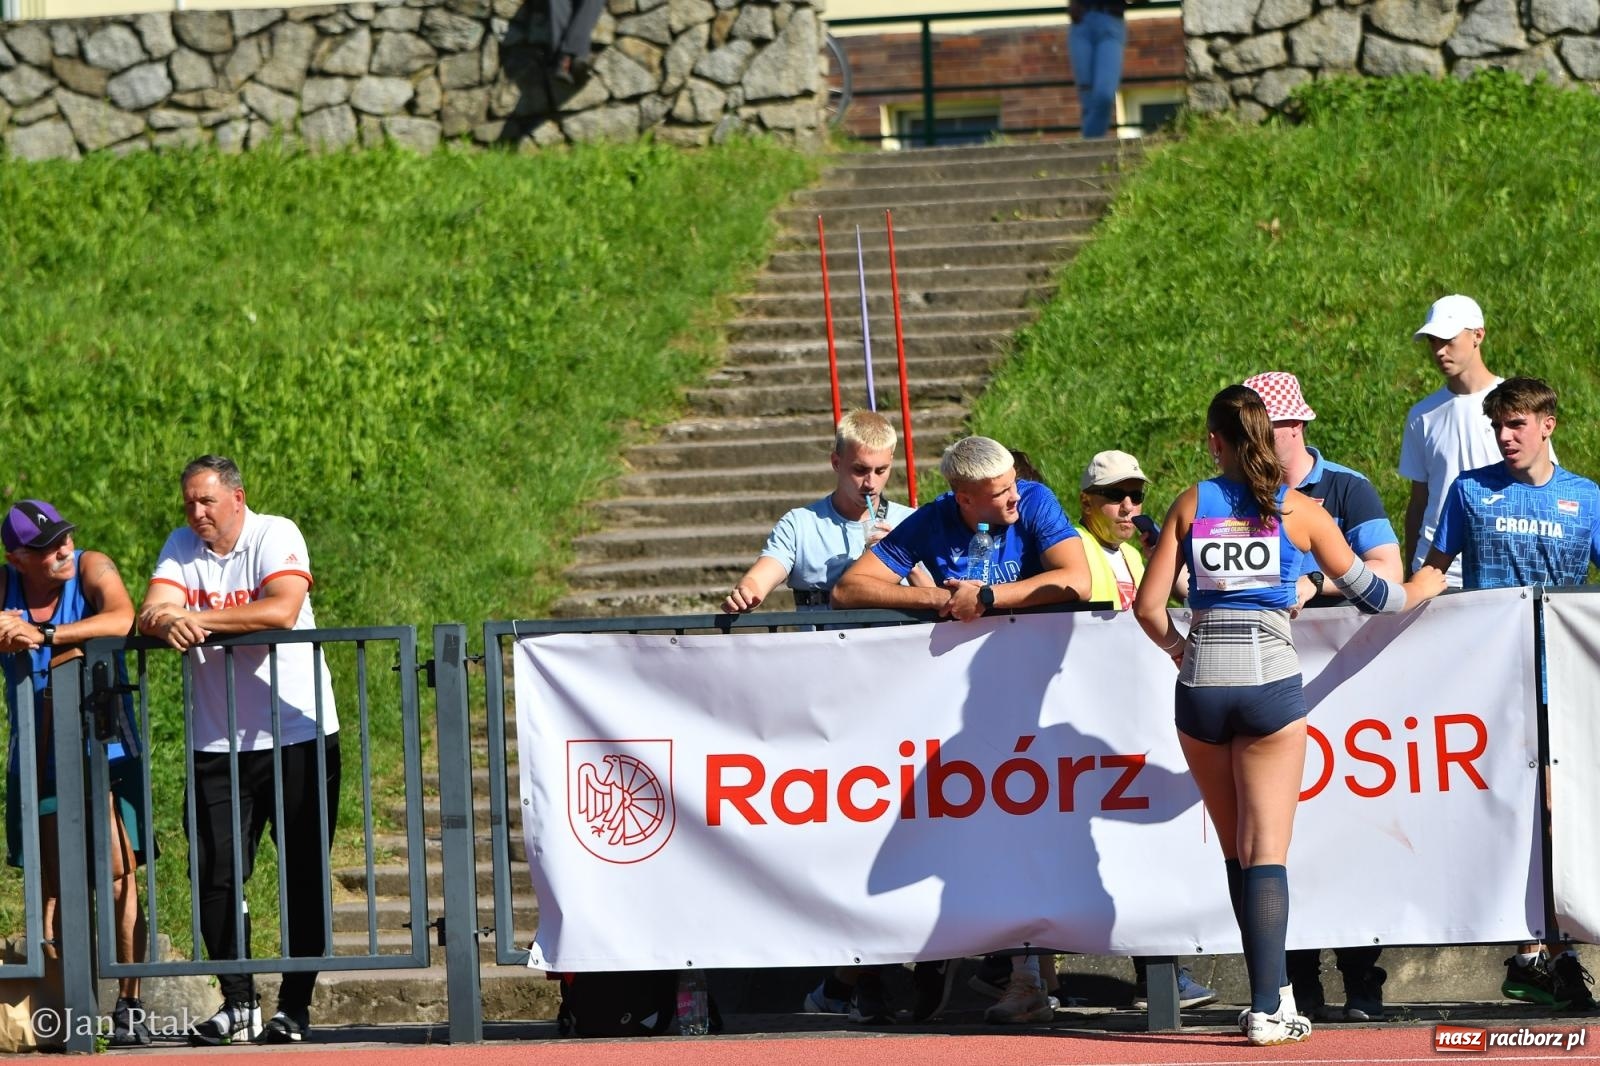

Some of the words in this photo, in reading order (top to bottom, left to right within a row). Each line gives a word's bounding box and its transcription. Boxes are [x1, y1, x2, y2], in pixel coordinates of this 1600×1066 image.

[1495, 516, 1564, 539] CROATIA
[1200, 541, 1271, 572] CRO
[186, 586, 261, 609] UNGARY
[706, 735, 1150, 826] Racibórz
